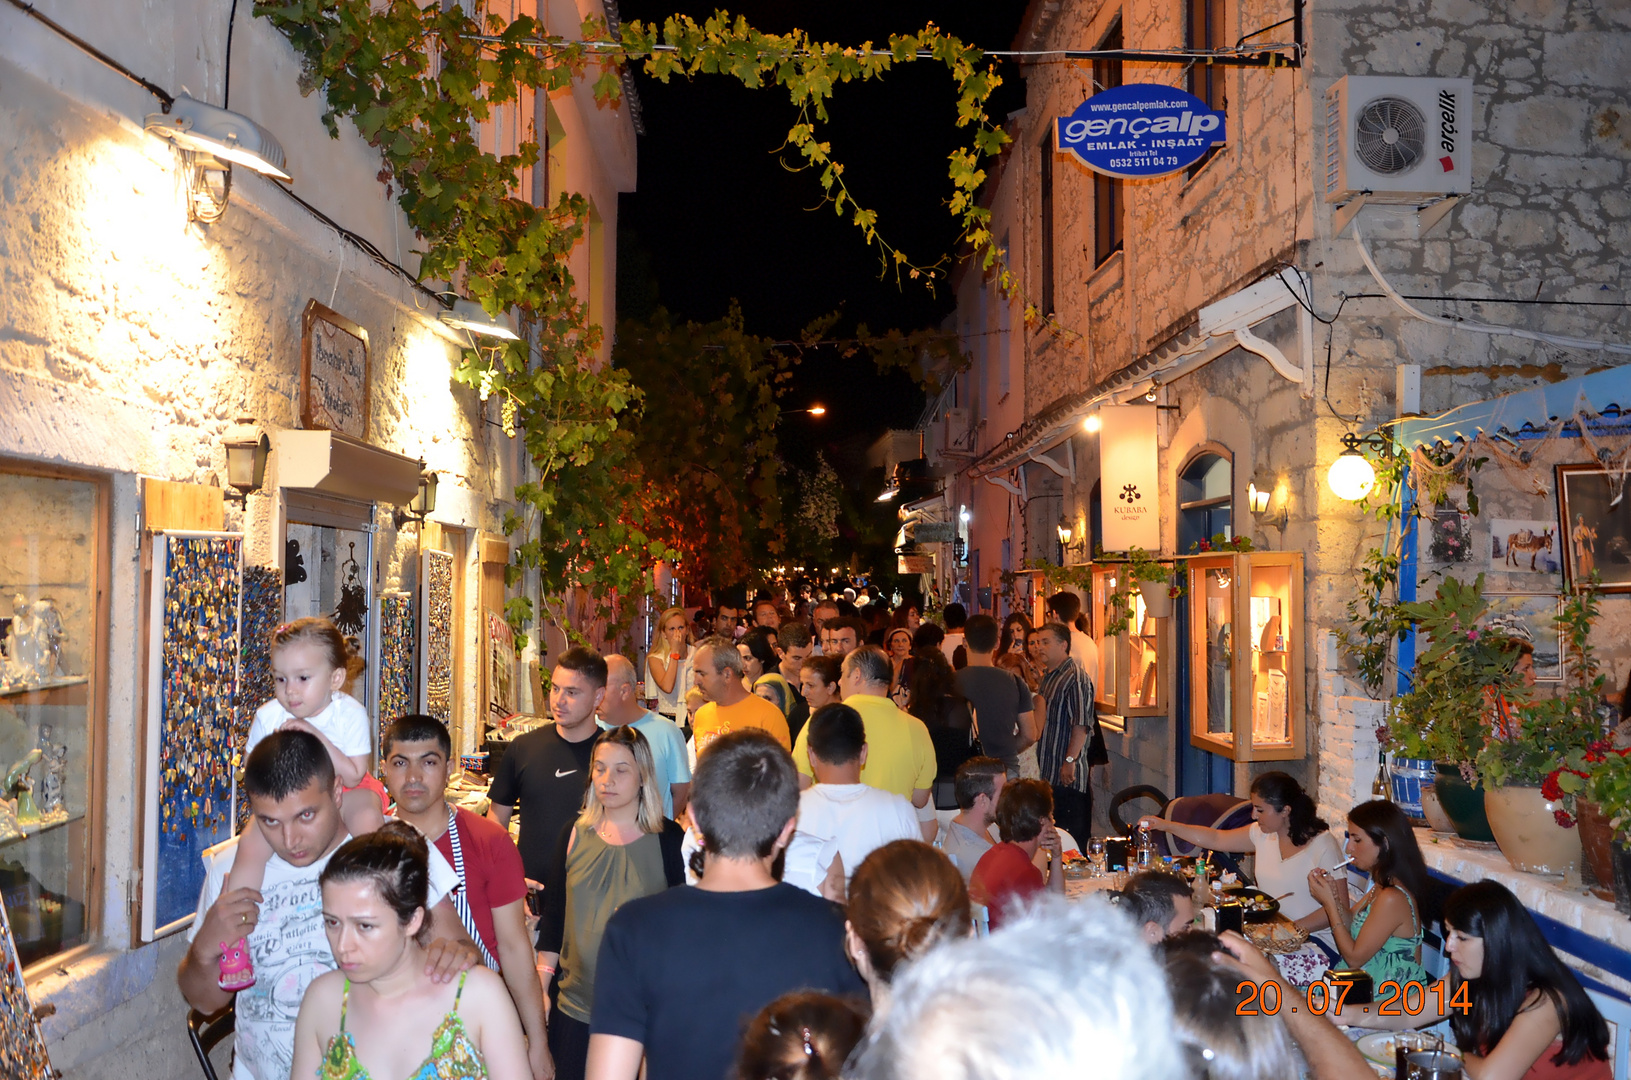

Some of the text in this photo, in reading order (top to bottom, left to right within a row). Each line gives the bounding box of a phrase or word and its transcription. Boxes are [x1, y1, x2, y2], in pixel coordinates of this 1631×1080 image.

[1090, 100, 1188, 112] www.gencalpemlak.com
[1064, 110, 1220, 143] gençalp
[1438, 89, 1458, 153] arçelik
[1087, 141, 1137, 151] EMLAK
[1110, 156, 1178, 168] 0532 511 04 79
[1113, 506, 1148, 514] KUBABA
